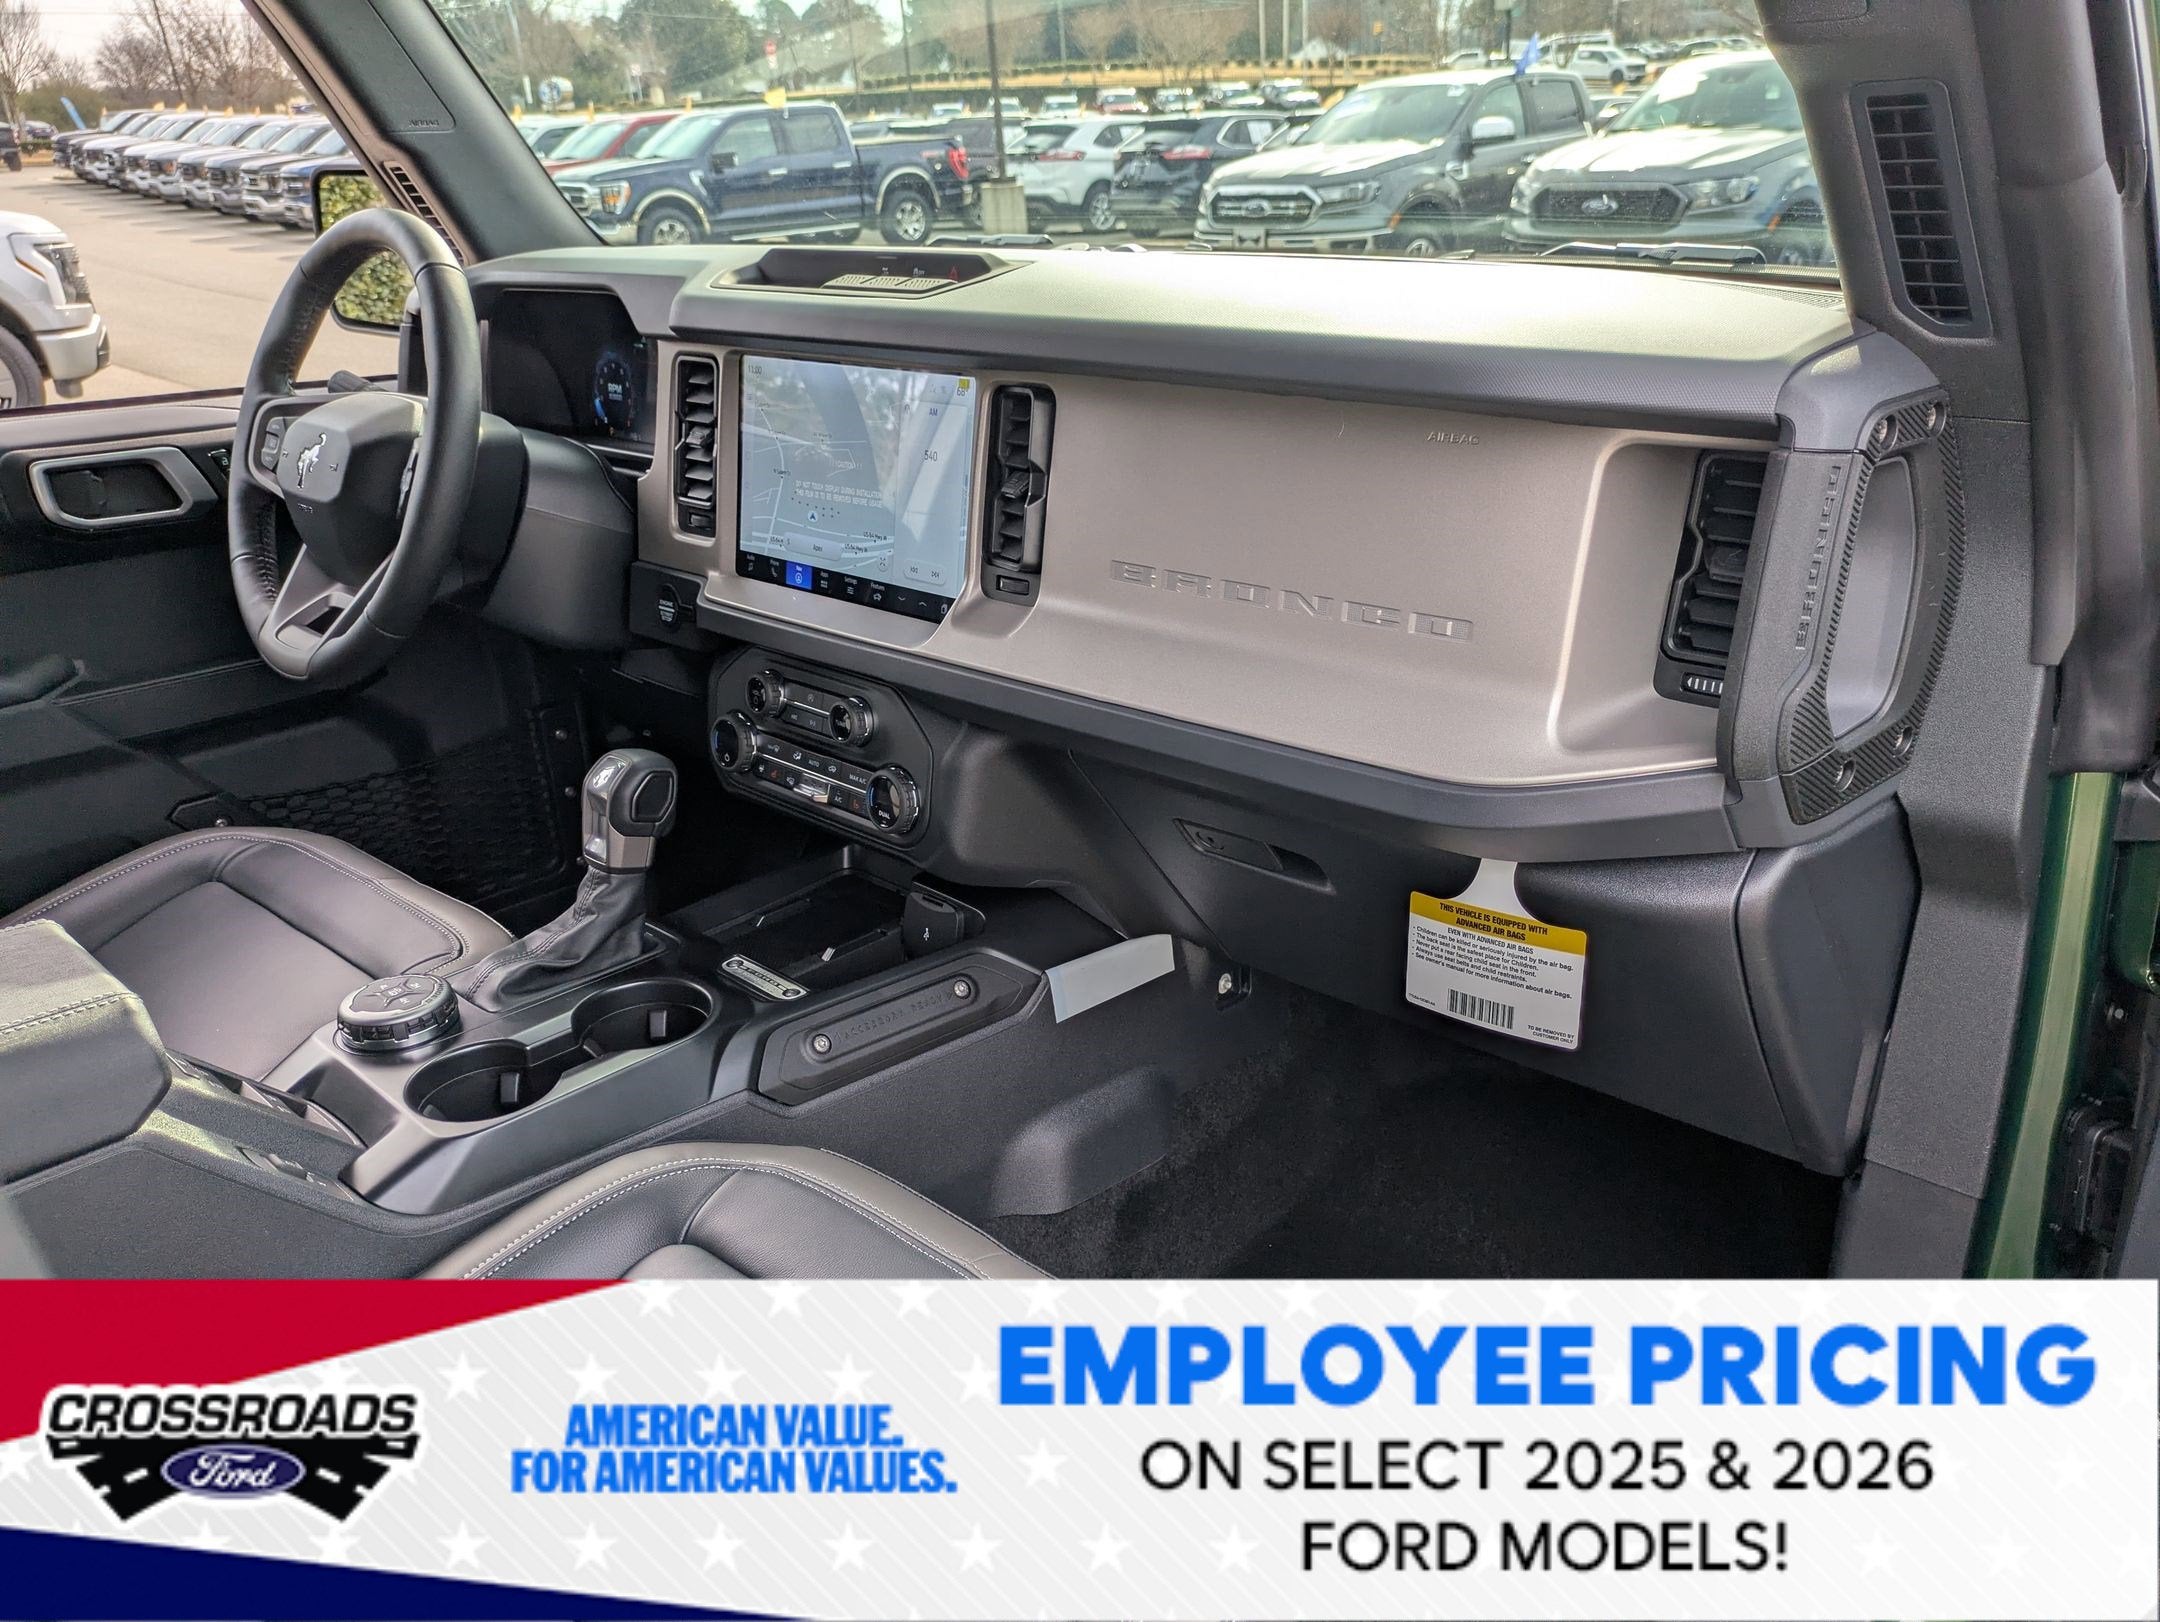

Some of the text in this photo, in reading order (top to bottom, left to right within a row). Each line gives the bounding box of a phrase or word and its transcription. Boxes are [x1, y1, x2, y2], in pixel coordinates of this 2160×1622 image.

[608, 382, 622, 394] RPM
[929, 408, 938, 416] AM
[1426, 430, 1480, 446] AIRBAG
[924, 450, 938, 462] 540
[1794, 465, 1841, 650] BRONCO
[1110, 558, 1474, 644] BRONCO
[808, 759, 820, 768] AUTO
[878, 810, 890, 820] DUAL
[1440, 903, 1548, 935] THIS VEHICLE IS EQUIPPED WITH
[1456, 918, 1526, 940] ADVANCED AIR BAGS
[1417, 926, 1437, 938] Children
[1457, 937, 1471, 947] killed
[1479, 944, 1505, 956] seriously
[1507, 951, 1528, 961] injured
[1529, 955, 1537, 964] by
[1560, 962, 1573, 971] bag.
[1448, 928, 1461, 936] EVEN
[1462, 932, 1476, 940] WITH
[1477, 936, 1505, 948] ADVANCED
[1518, 946, 1534, 954] BAGS
[1416, 940, 1430, 948] Never
[1456, 952, 1472, 962] facing
[1474, 956, 1488, 965] child
[1489, 960, 1501, 968] seat
[1510, 965, 1519, 973] the
[1520, 968, 1536, 977] front.
[1416, 946, 1433, 956] Always
[1456, 959, 1469, 967] belts
[1482, 966, 1496, 974] child
[1498, 970, 1527, 982] restraints.
[1427, 936, 1438, 944] back
[1457, 944, 1466, 952] the
[1467, 947, 1484, 957] safest
[1485, 952, 1500, 962] place
[1511, 960, 1538, 971] Children.
[1416, 952, 1424, 960] See
[1426, 957, 1445, 966] owner's
[1446, 963, 1465, 972] manual
[1491, 975, 1524, 989] information
[1526, 984, 1544, 993] about
[1554, 990, 1572, 999] bags.
[1533, 1031, 1559, 1040] CUSTOMER
[1543, 1029, 1566, 1037] REMOVED
